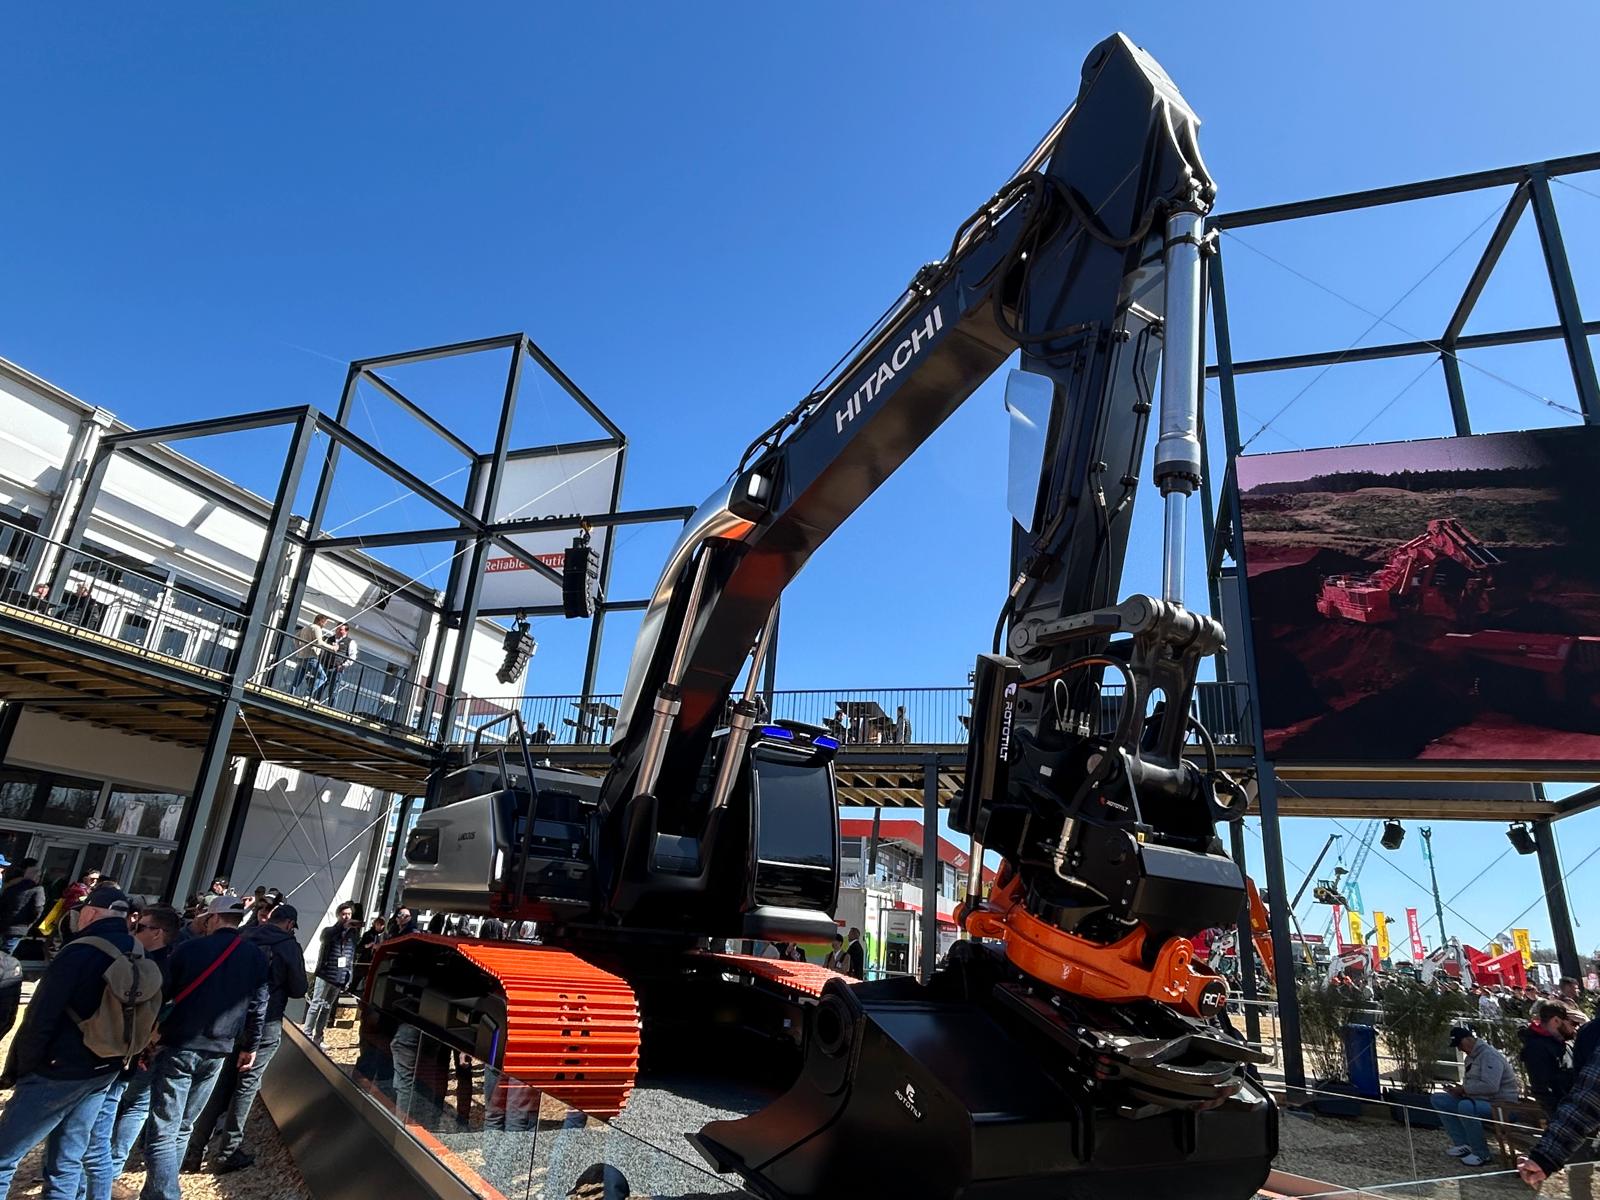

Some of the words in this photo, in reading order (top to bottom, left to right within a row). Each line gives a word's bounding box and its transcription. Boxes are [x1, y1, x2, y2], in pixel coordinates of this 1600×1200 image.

[835, 305, 943, 434] HITACHI
[485, 558, 525, 571] Reliable
[999, 701, 1013, 762] ROTOTILT
[894, 1090, 922, 1119] ROTOTILT
